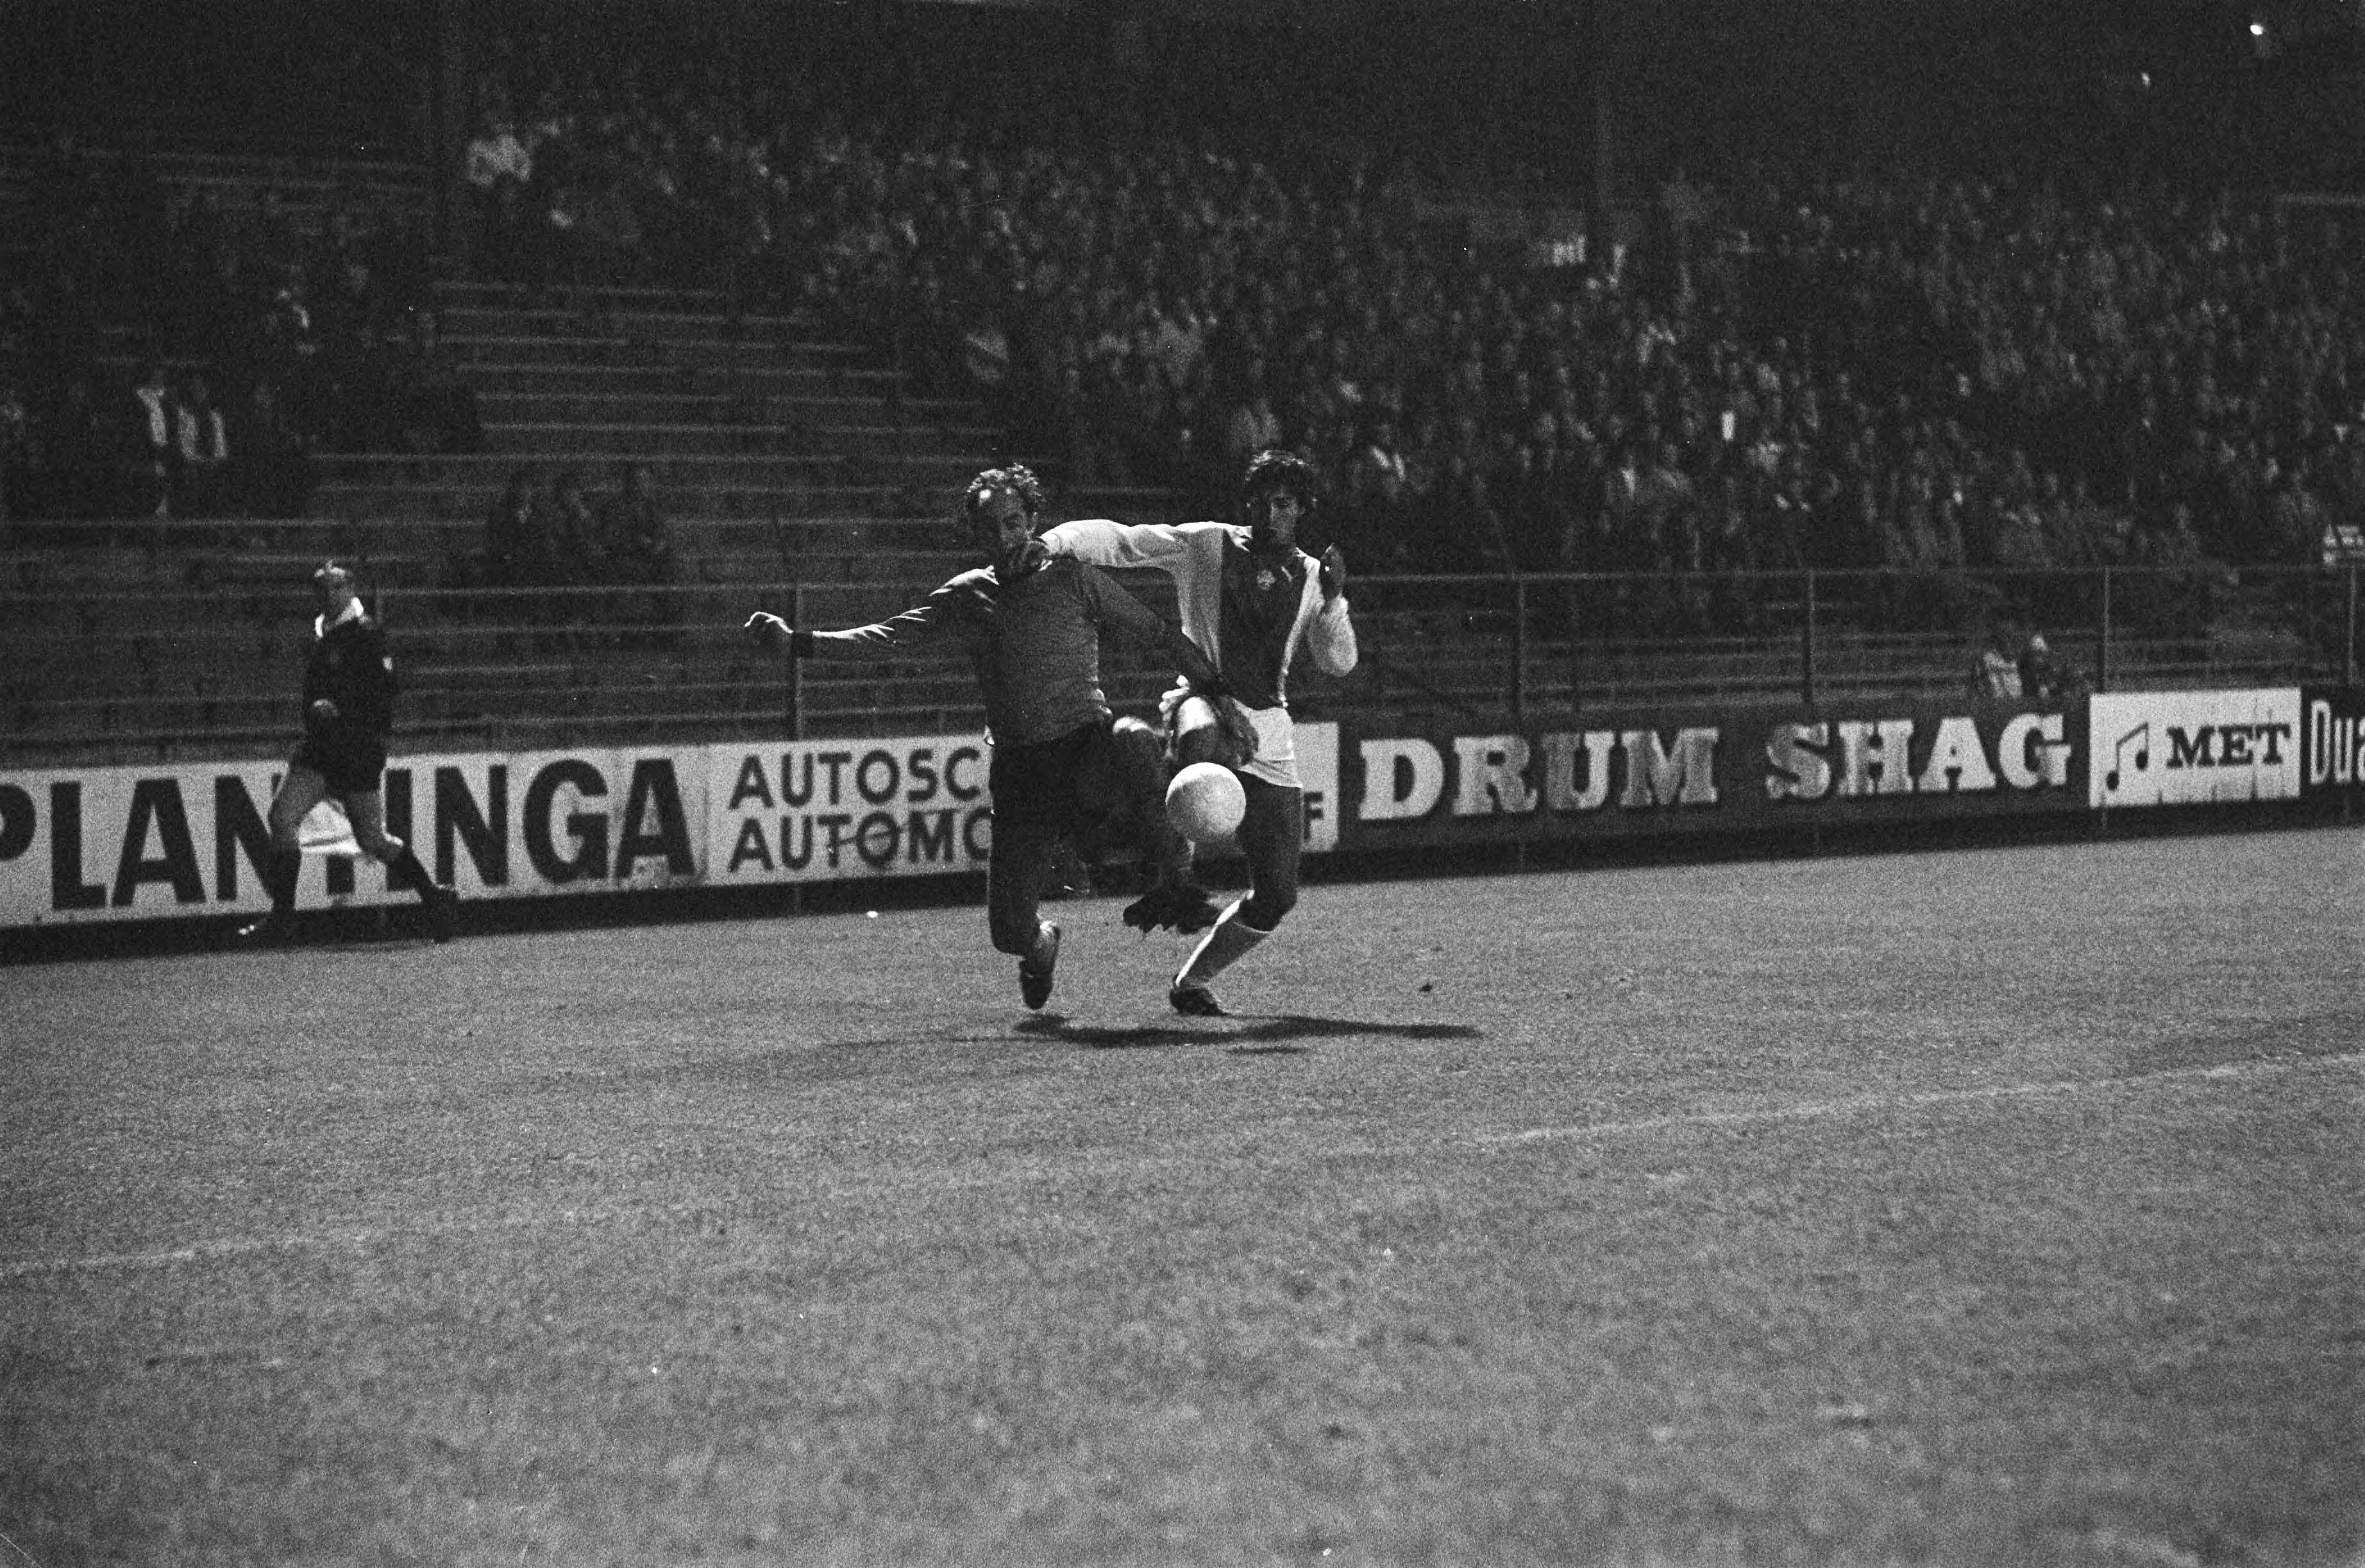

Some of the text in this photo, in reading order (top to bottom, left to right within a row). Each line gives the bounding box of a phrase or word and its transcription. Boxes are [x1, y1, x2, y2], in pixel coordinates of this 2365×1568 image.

[1359, 713, 2072, 820] DRUM SHAG
[2166, 723, 2291, 768] MET
[728, 747, 981, 811] AUTOSC
[728, 807, 993, 873] AUTOMO
